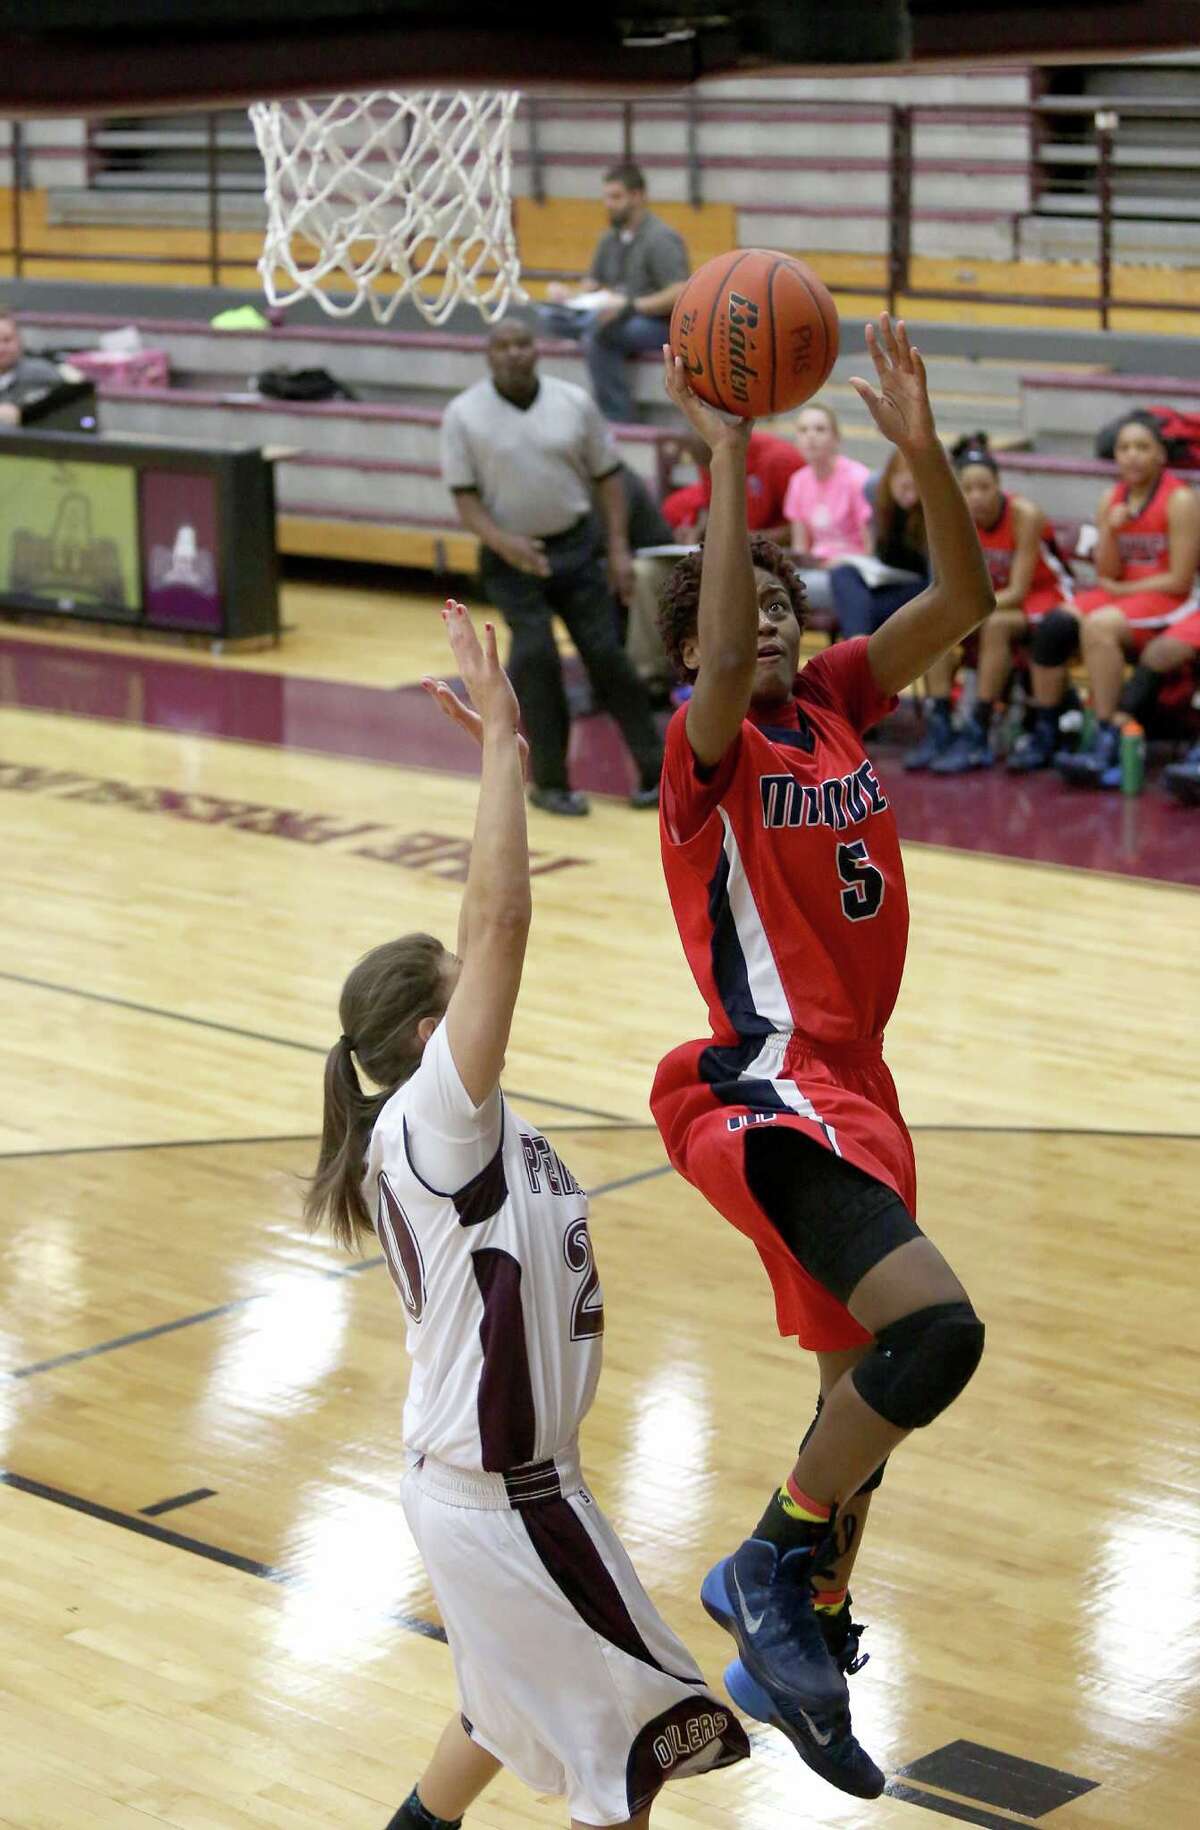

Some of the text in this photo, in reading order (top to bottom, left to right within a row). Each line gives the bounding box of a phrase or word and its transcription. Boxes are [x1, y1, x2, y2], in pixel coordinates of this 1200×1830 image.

[729, 290, 759, 402] Baden
[836, 838, 885, 923] 5
[563, 1217, 604, 1342] 2
[653, 1711, 728, 1769] OILERS
